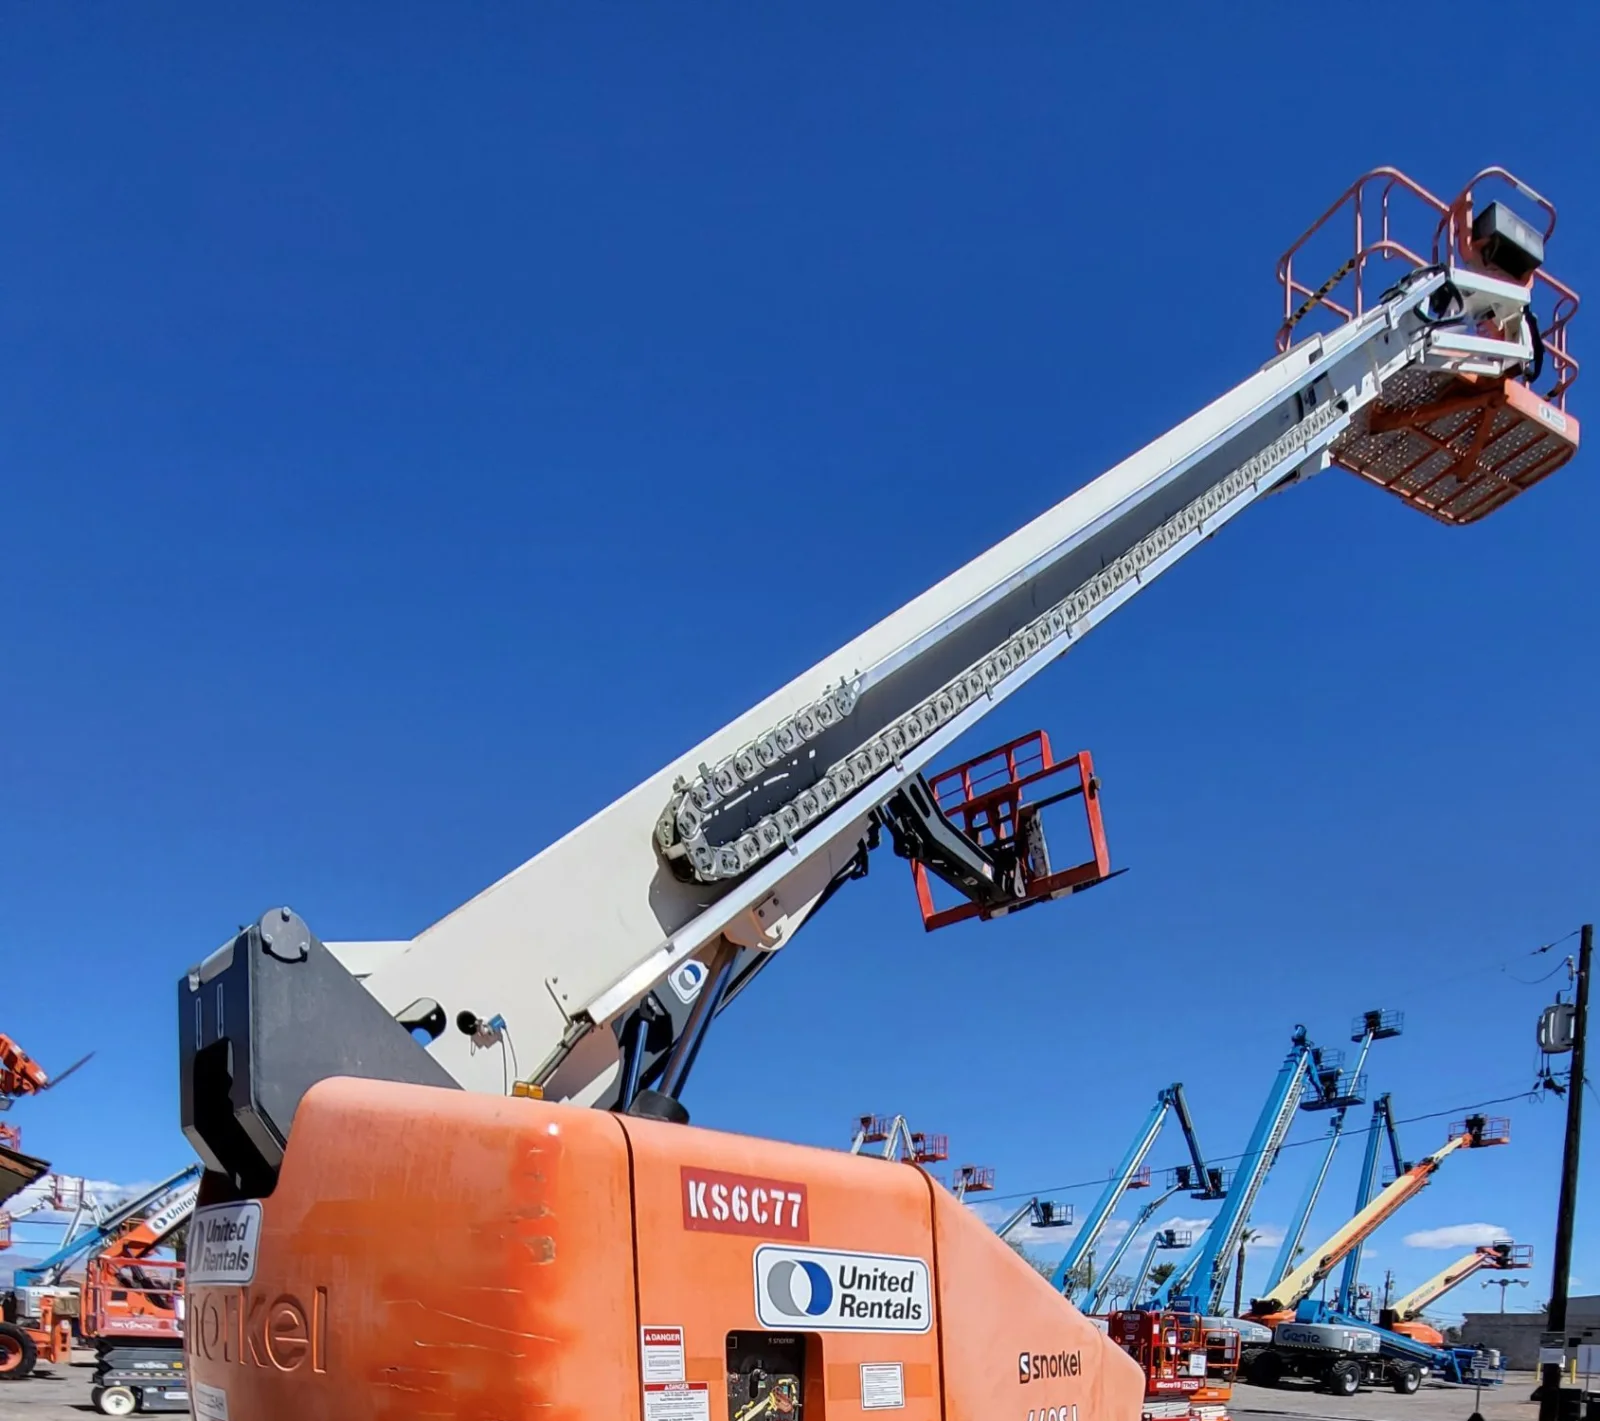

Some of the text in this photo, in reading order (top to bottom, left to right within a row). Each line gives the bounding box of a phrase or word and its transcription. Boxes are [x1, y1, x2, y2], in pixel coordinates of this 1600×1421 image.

[688, 1180, 802, 1228] KS6C77
[206, 1215, 251, 1243] United
[202, 1245, 250, 1272] Rentals
[838, 1265, 915, 1293] United
[839, 1293, 922, 1320] Rentals
[651, 1333, 680, 1341] DANGER
[1282, 1328, 1320, 1344] Genie
[1032, 1350, 1081, 1379] snorkel
